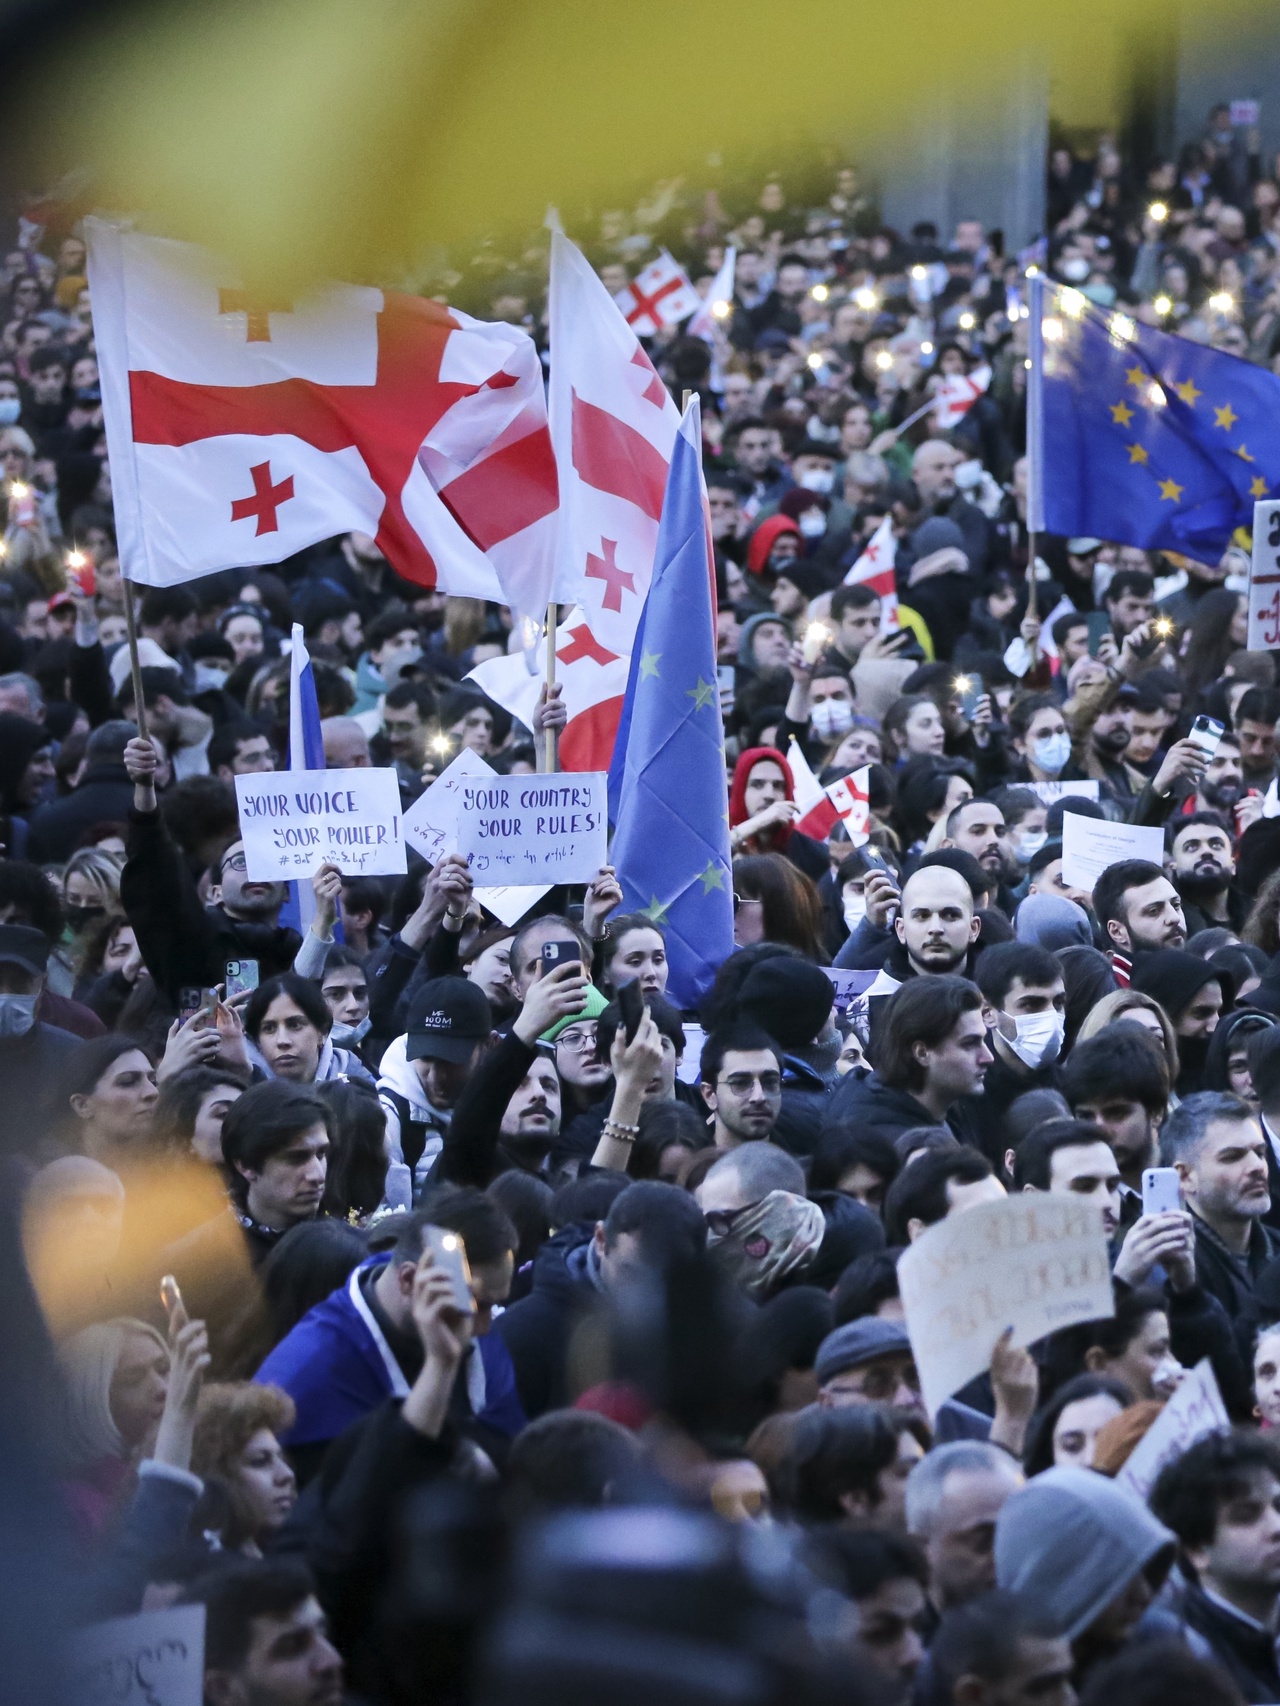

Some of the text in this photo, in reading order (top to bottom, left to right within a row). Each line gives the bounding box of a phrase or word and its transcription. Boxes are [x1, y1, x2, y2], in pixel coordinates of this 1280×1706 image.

[243, 791, 359, 817] YOUR VOICE
[463, 787, 592, 811] YOUR COUNTRY
[273, 826, 320, 849] YOUR
[327, 815, 398, 846] POWER!
[478, 812, 601, 838] YOUR RULES!
